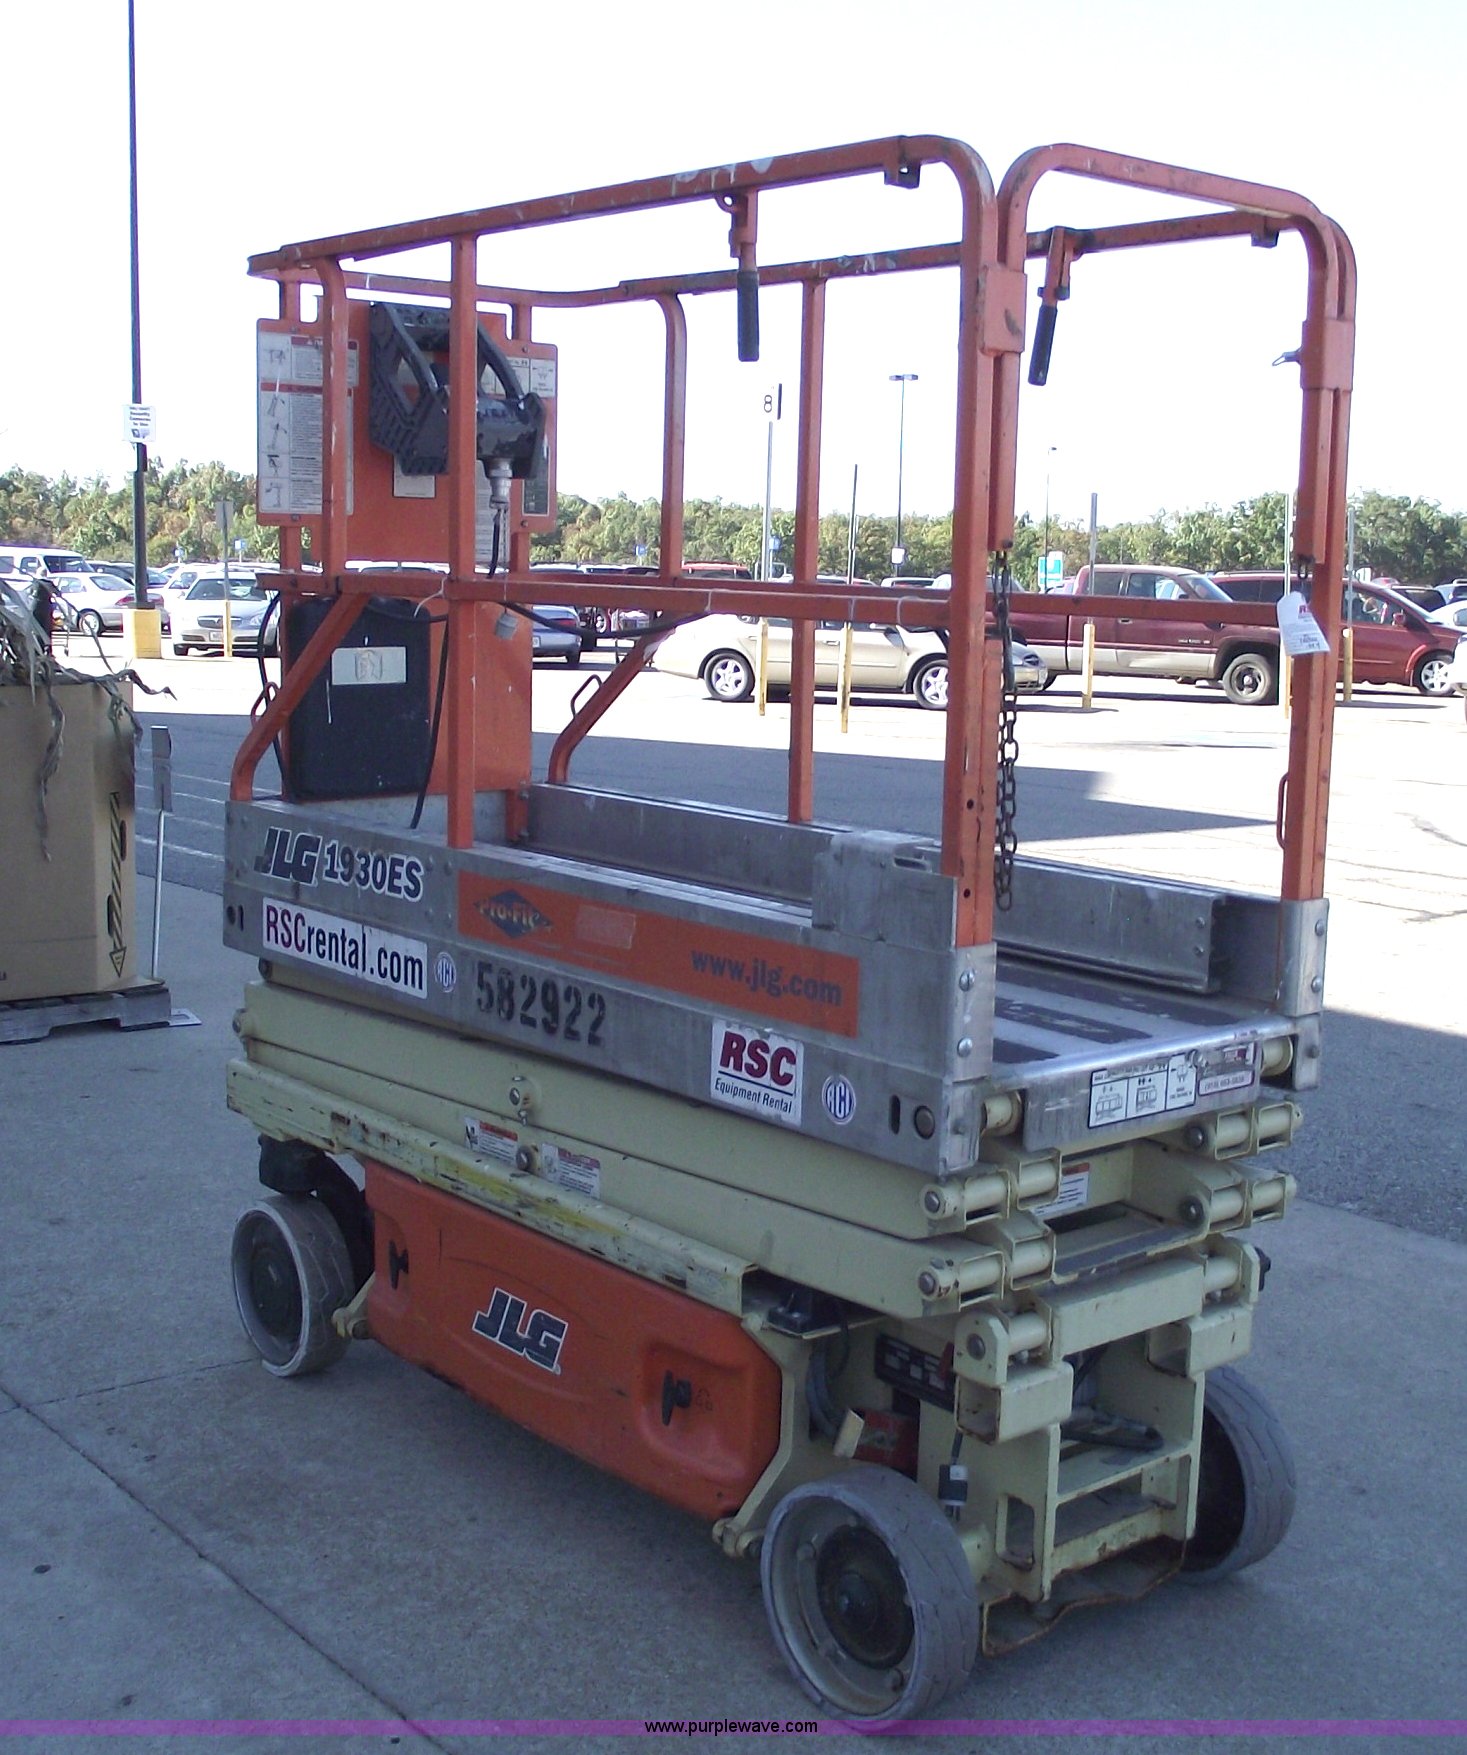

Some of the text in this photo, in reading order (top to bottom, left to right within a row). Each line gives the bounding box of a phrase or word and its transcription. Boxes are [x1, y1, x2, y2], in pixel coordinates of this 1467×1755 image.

[253, 826, 423, 901] JLG 1930ES
[265, 904, 425, 991] RSCrental.com
[691, 951, 842, 1006] www.jlg.com
[477, 960, 606, 1047] 582922
[714, 1077, 793, 1114] Equipment Rental
[719, 1030, 797, 1087] RSC
[472, 1287, 568, 1371] JLG
